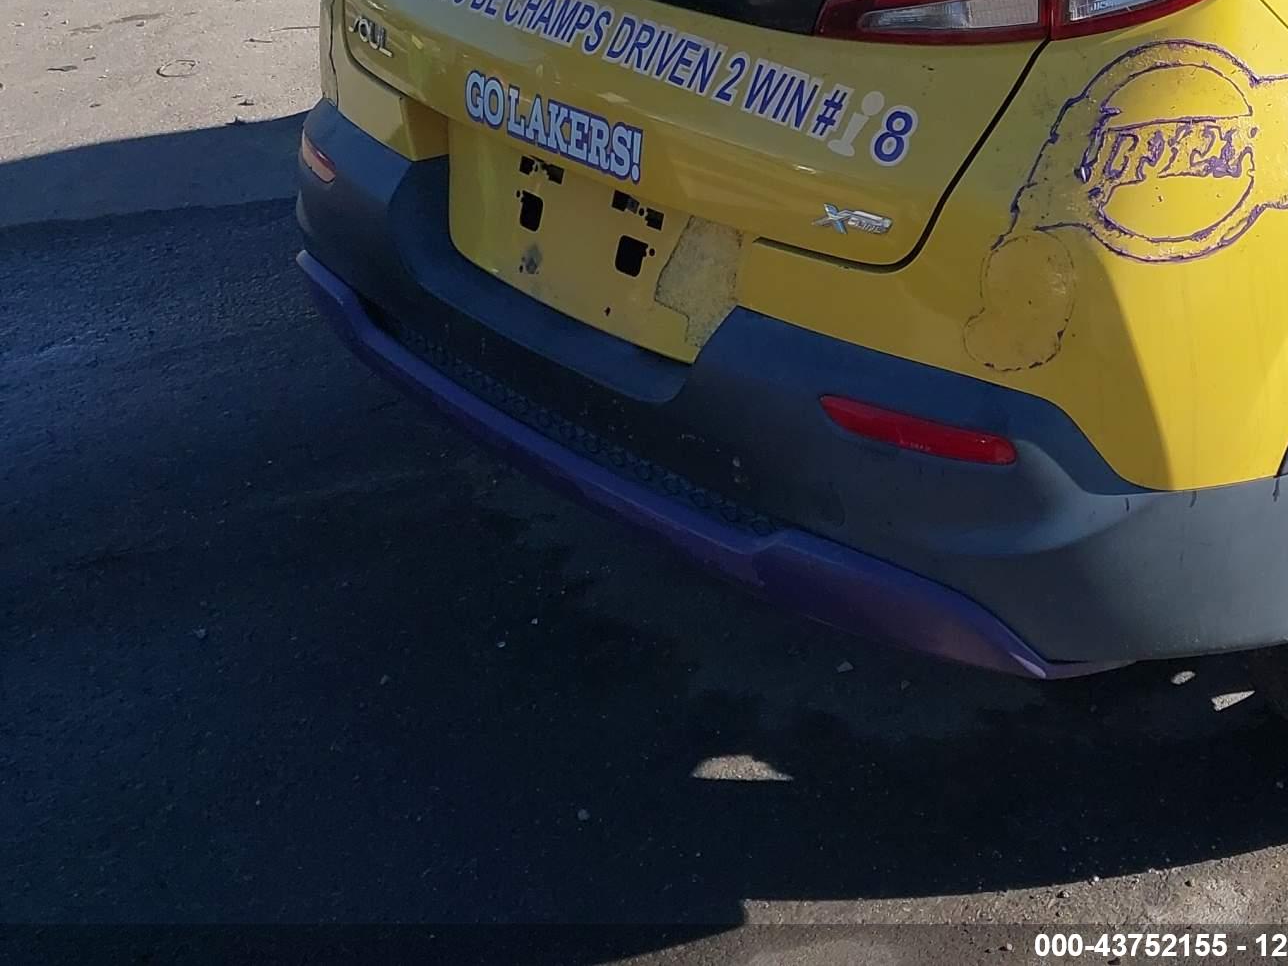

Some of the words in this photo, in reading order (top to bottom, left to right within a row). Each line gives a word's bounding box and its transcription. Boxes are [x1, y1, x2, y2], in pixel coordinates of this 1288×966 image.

[465, 70, 504, 130] GO
[507, 84, 643, 184] LAKERS!
[607, 16, 722, 93] DRIVEN
[715, 57, 746, 102] 2
[744, 63, 820, 129] WIN
